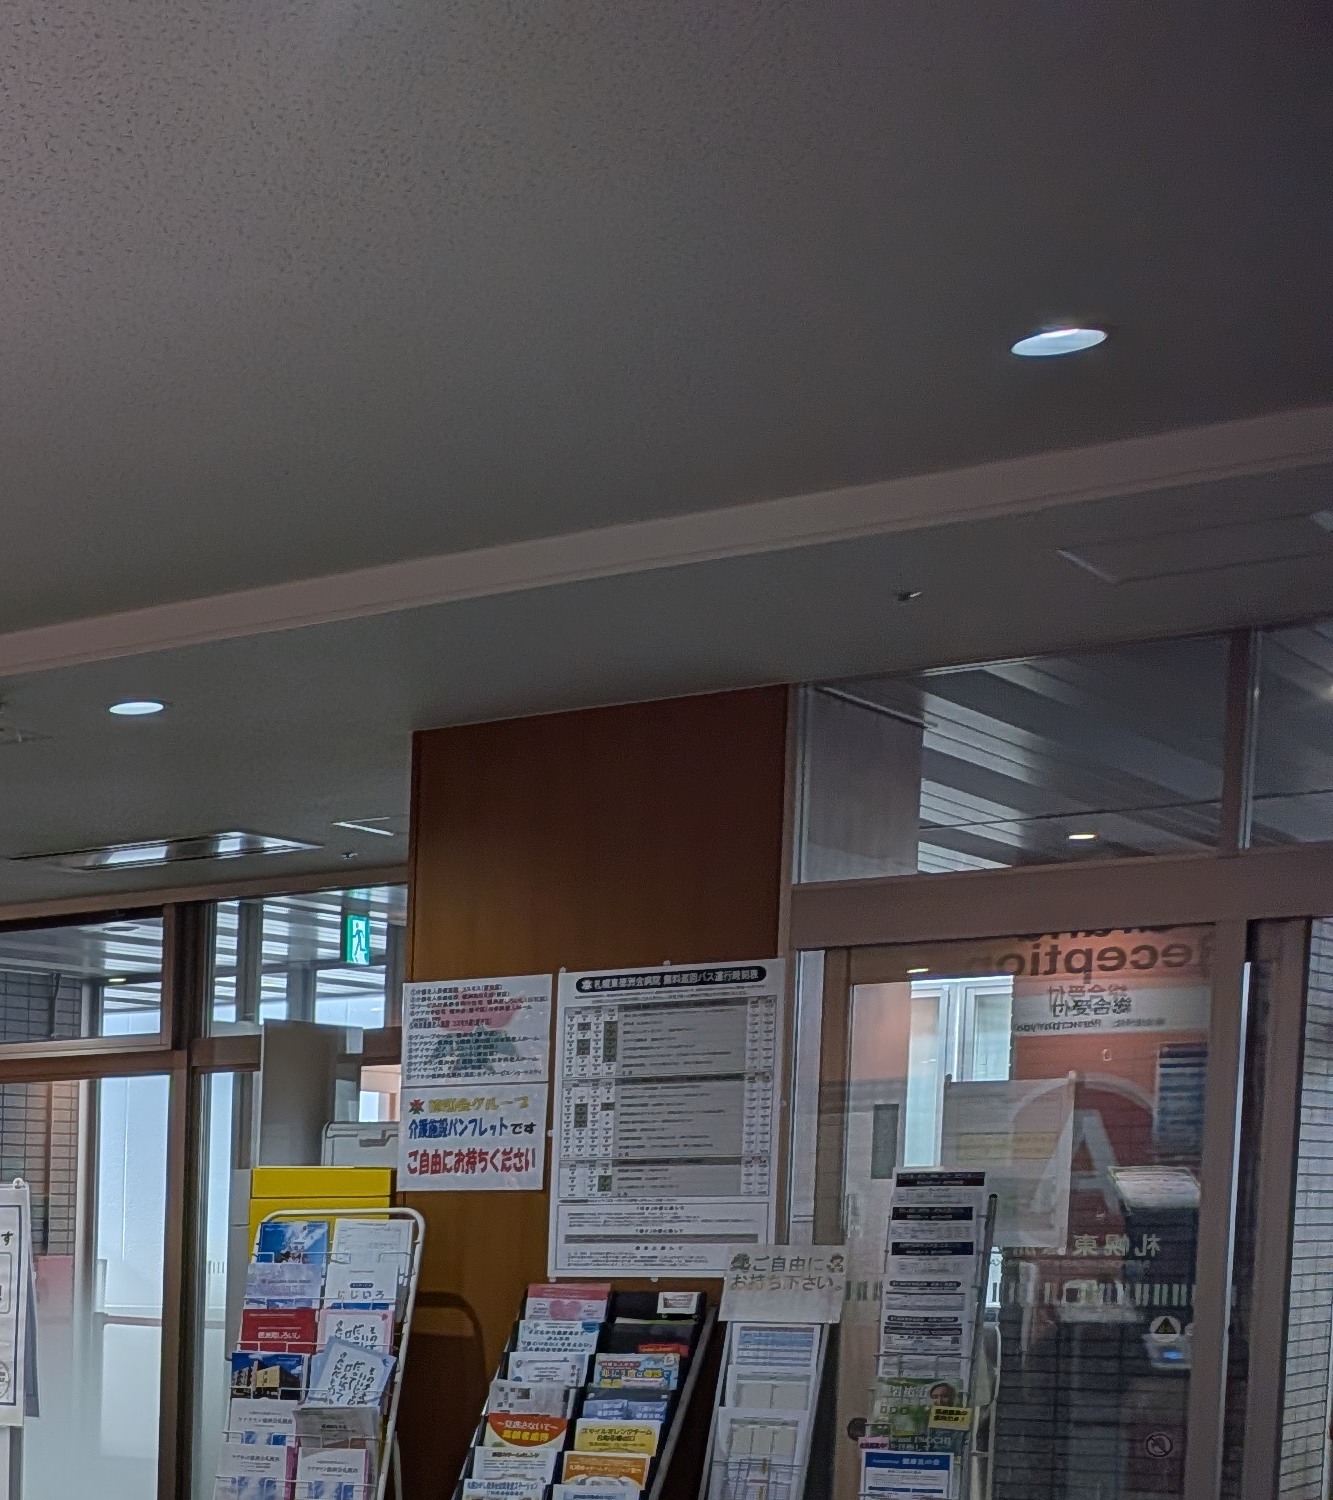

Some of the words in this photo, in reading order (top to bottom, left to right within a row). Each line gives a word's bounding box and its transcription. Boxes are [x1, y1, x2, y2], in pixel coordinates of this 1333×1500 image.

[409, 1117, 537, 1140] 介護施設パンフレットです
[407, 1147, 536, 1176] ご自由にお持ちください
[753, 1255, 824, 1272] ご自由に
